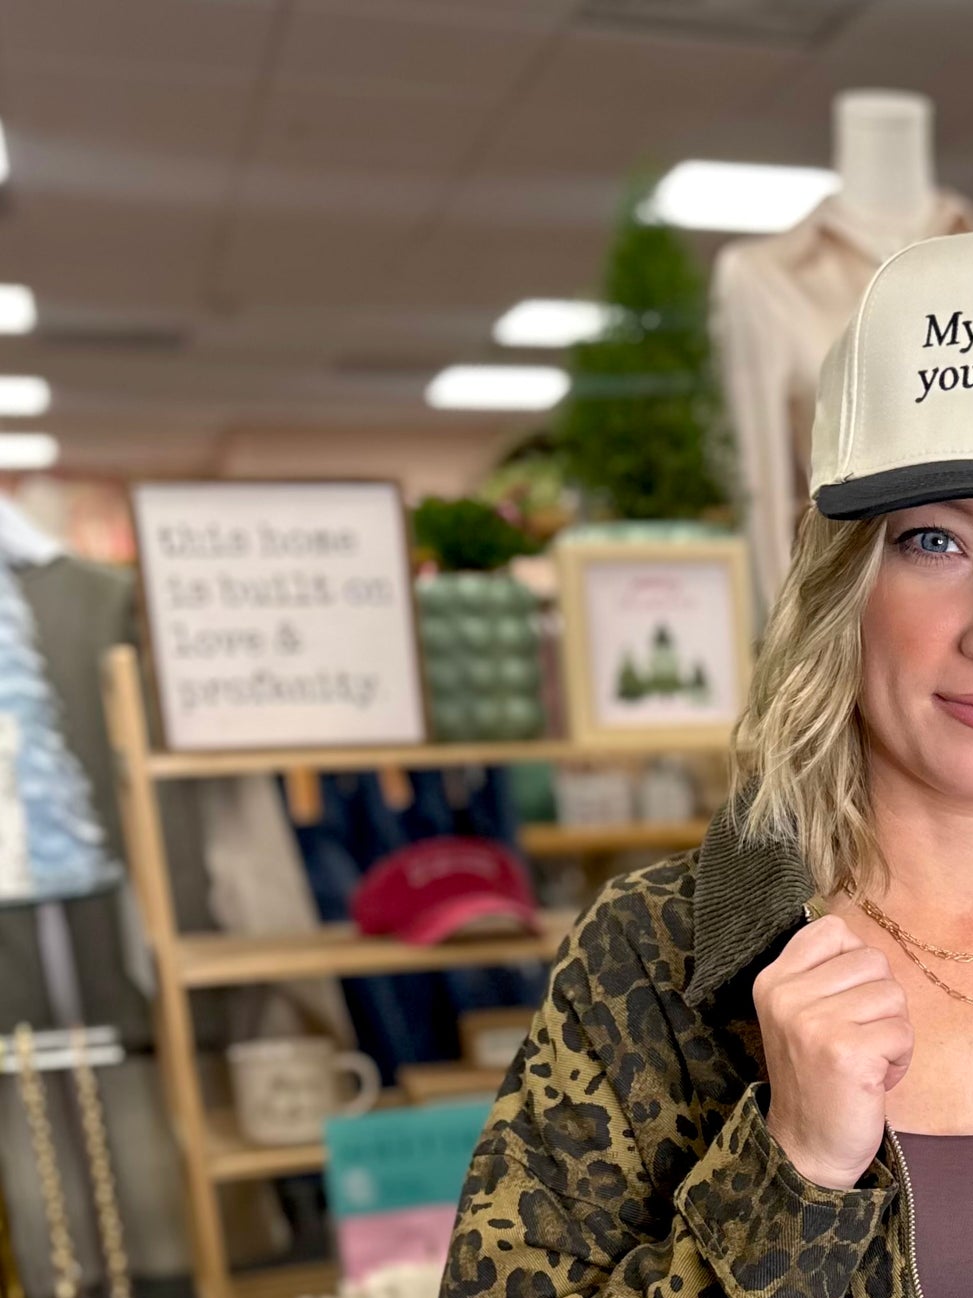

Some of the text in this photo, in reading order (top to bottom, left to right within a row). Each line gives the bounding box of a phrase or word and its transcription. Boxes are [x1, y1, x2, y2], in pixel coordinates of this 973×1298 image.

[157, 520, 358, 558] this home
[167, 571, 394, 609] is built on
[172, 617, 303, 658] love &
